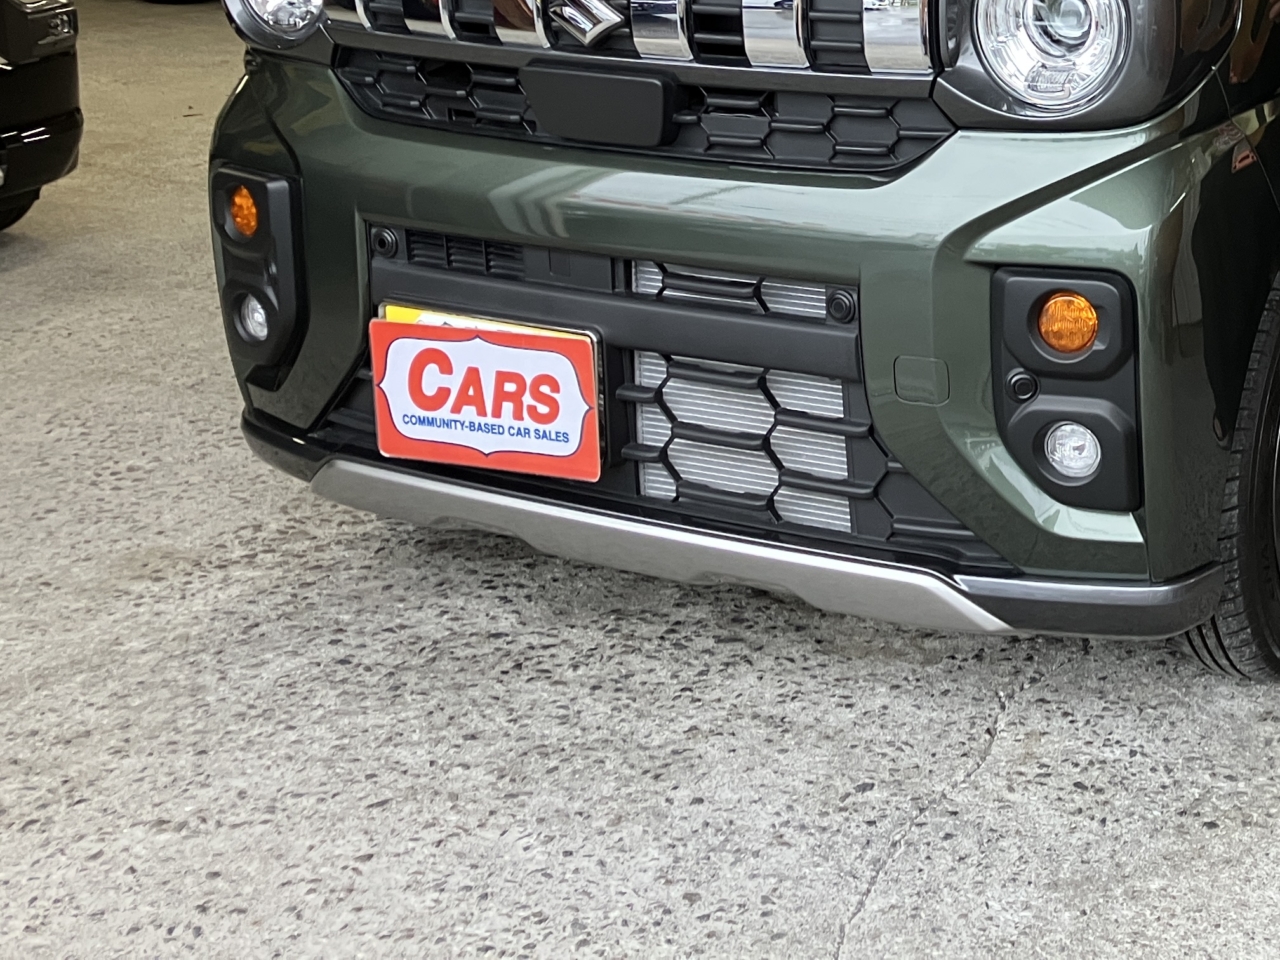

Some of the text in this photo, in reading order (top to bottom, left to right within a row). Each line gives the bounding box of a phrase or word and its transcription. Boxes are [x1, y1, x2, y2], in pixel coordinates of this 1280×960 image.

[408, 347, 560, 425] CARS
[402, 413, 570, 444] COMMUNITY-BASED CAR SALES
